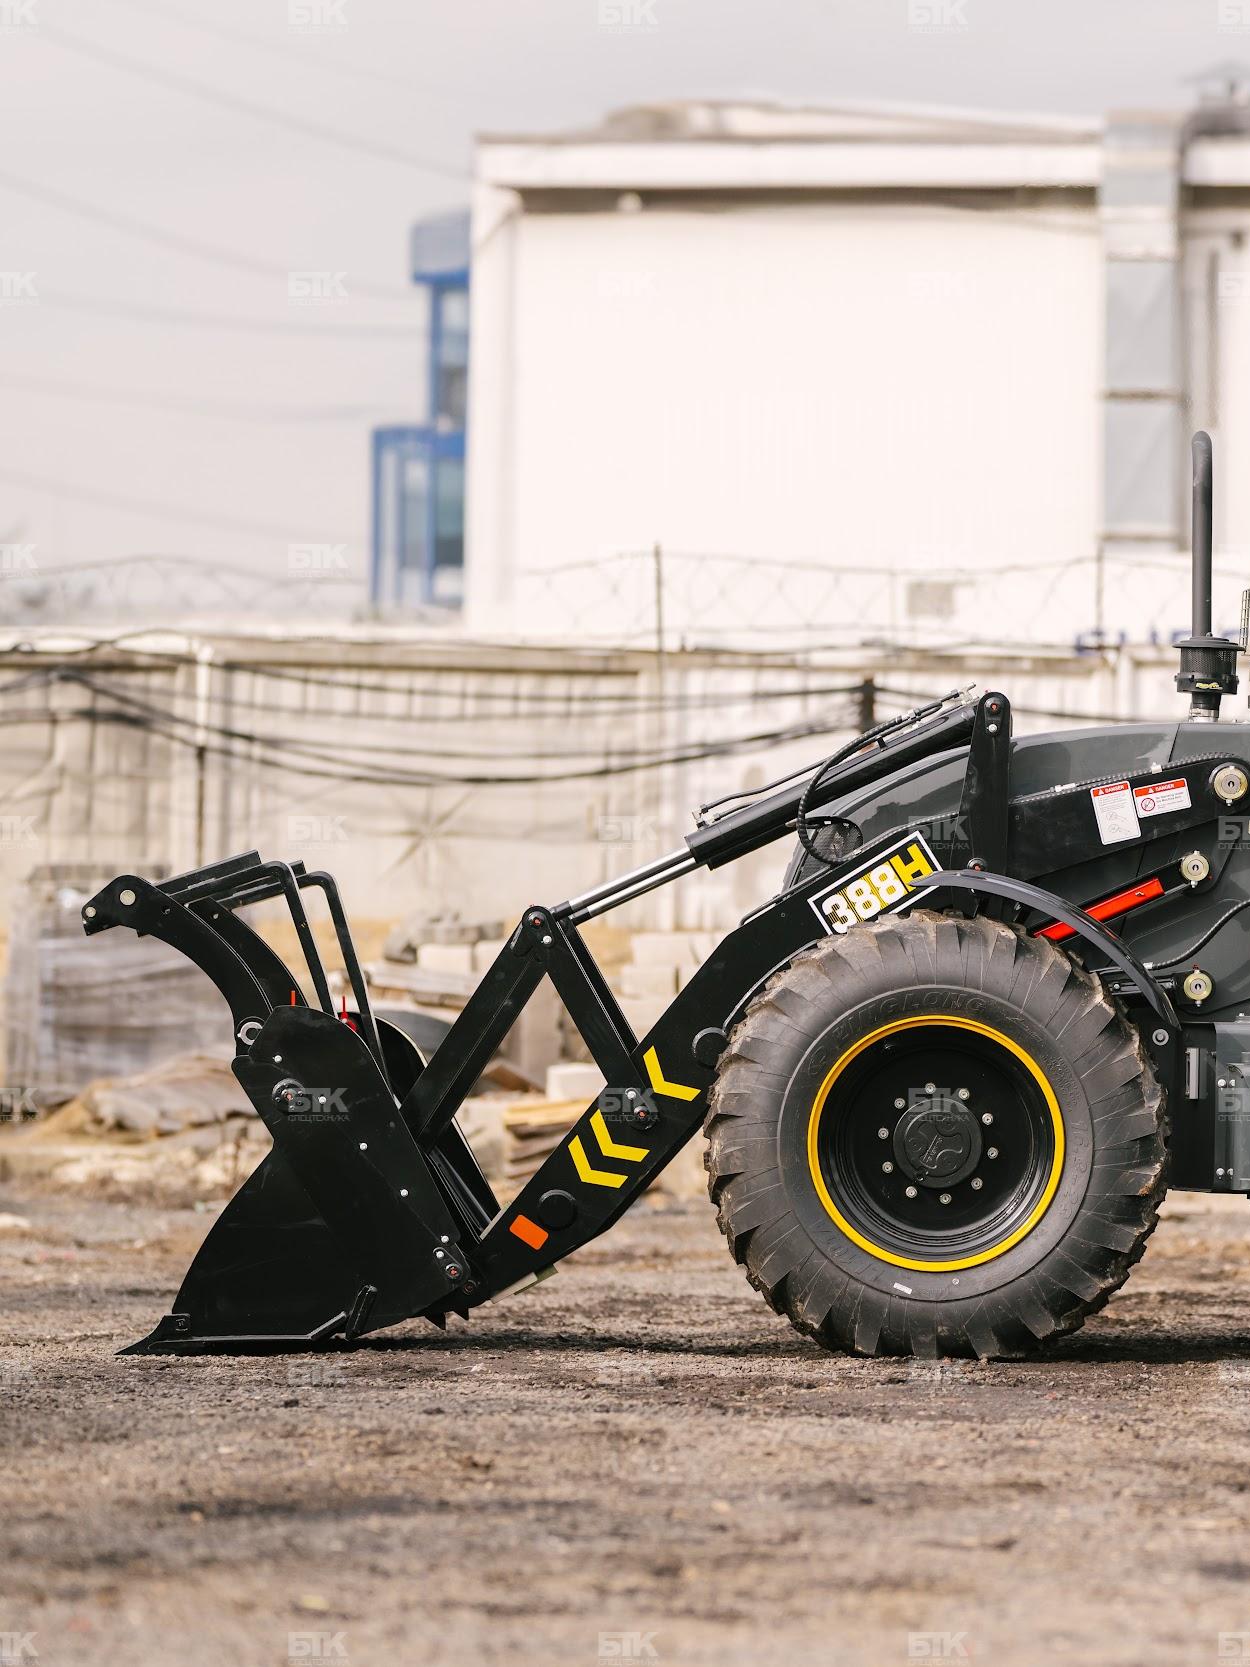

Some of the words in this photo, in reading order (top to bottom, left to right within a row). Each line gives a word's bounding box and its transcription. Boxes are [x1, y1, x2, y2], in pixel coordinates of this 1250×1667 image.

[1104, 784, 1125, 793] DANGER
[1155, 783, 1175, 792] DANGER
[821, 843, 933, 934] 388H
